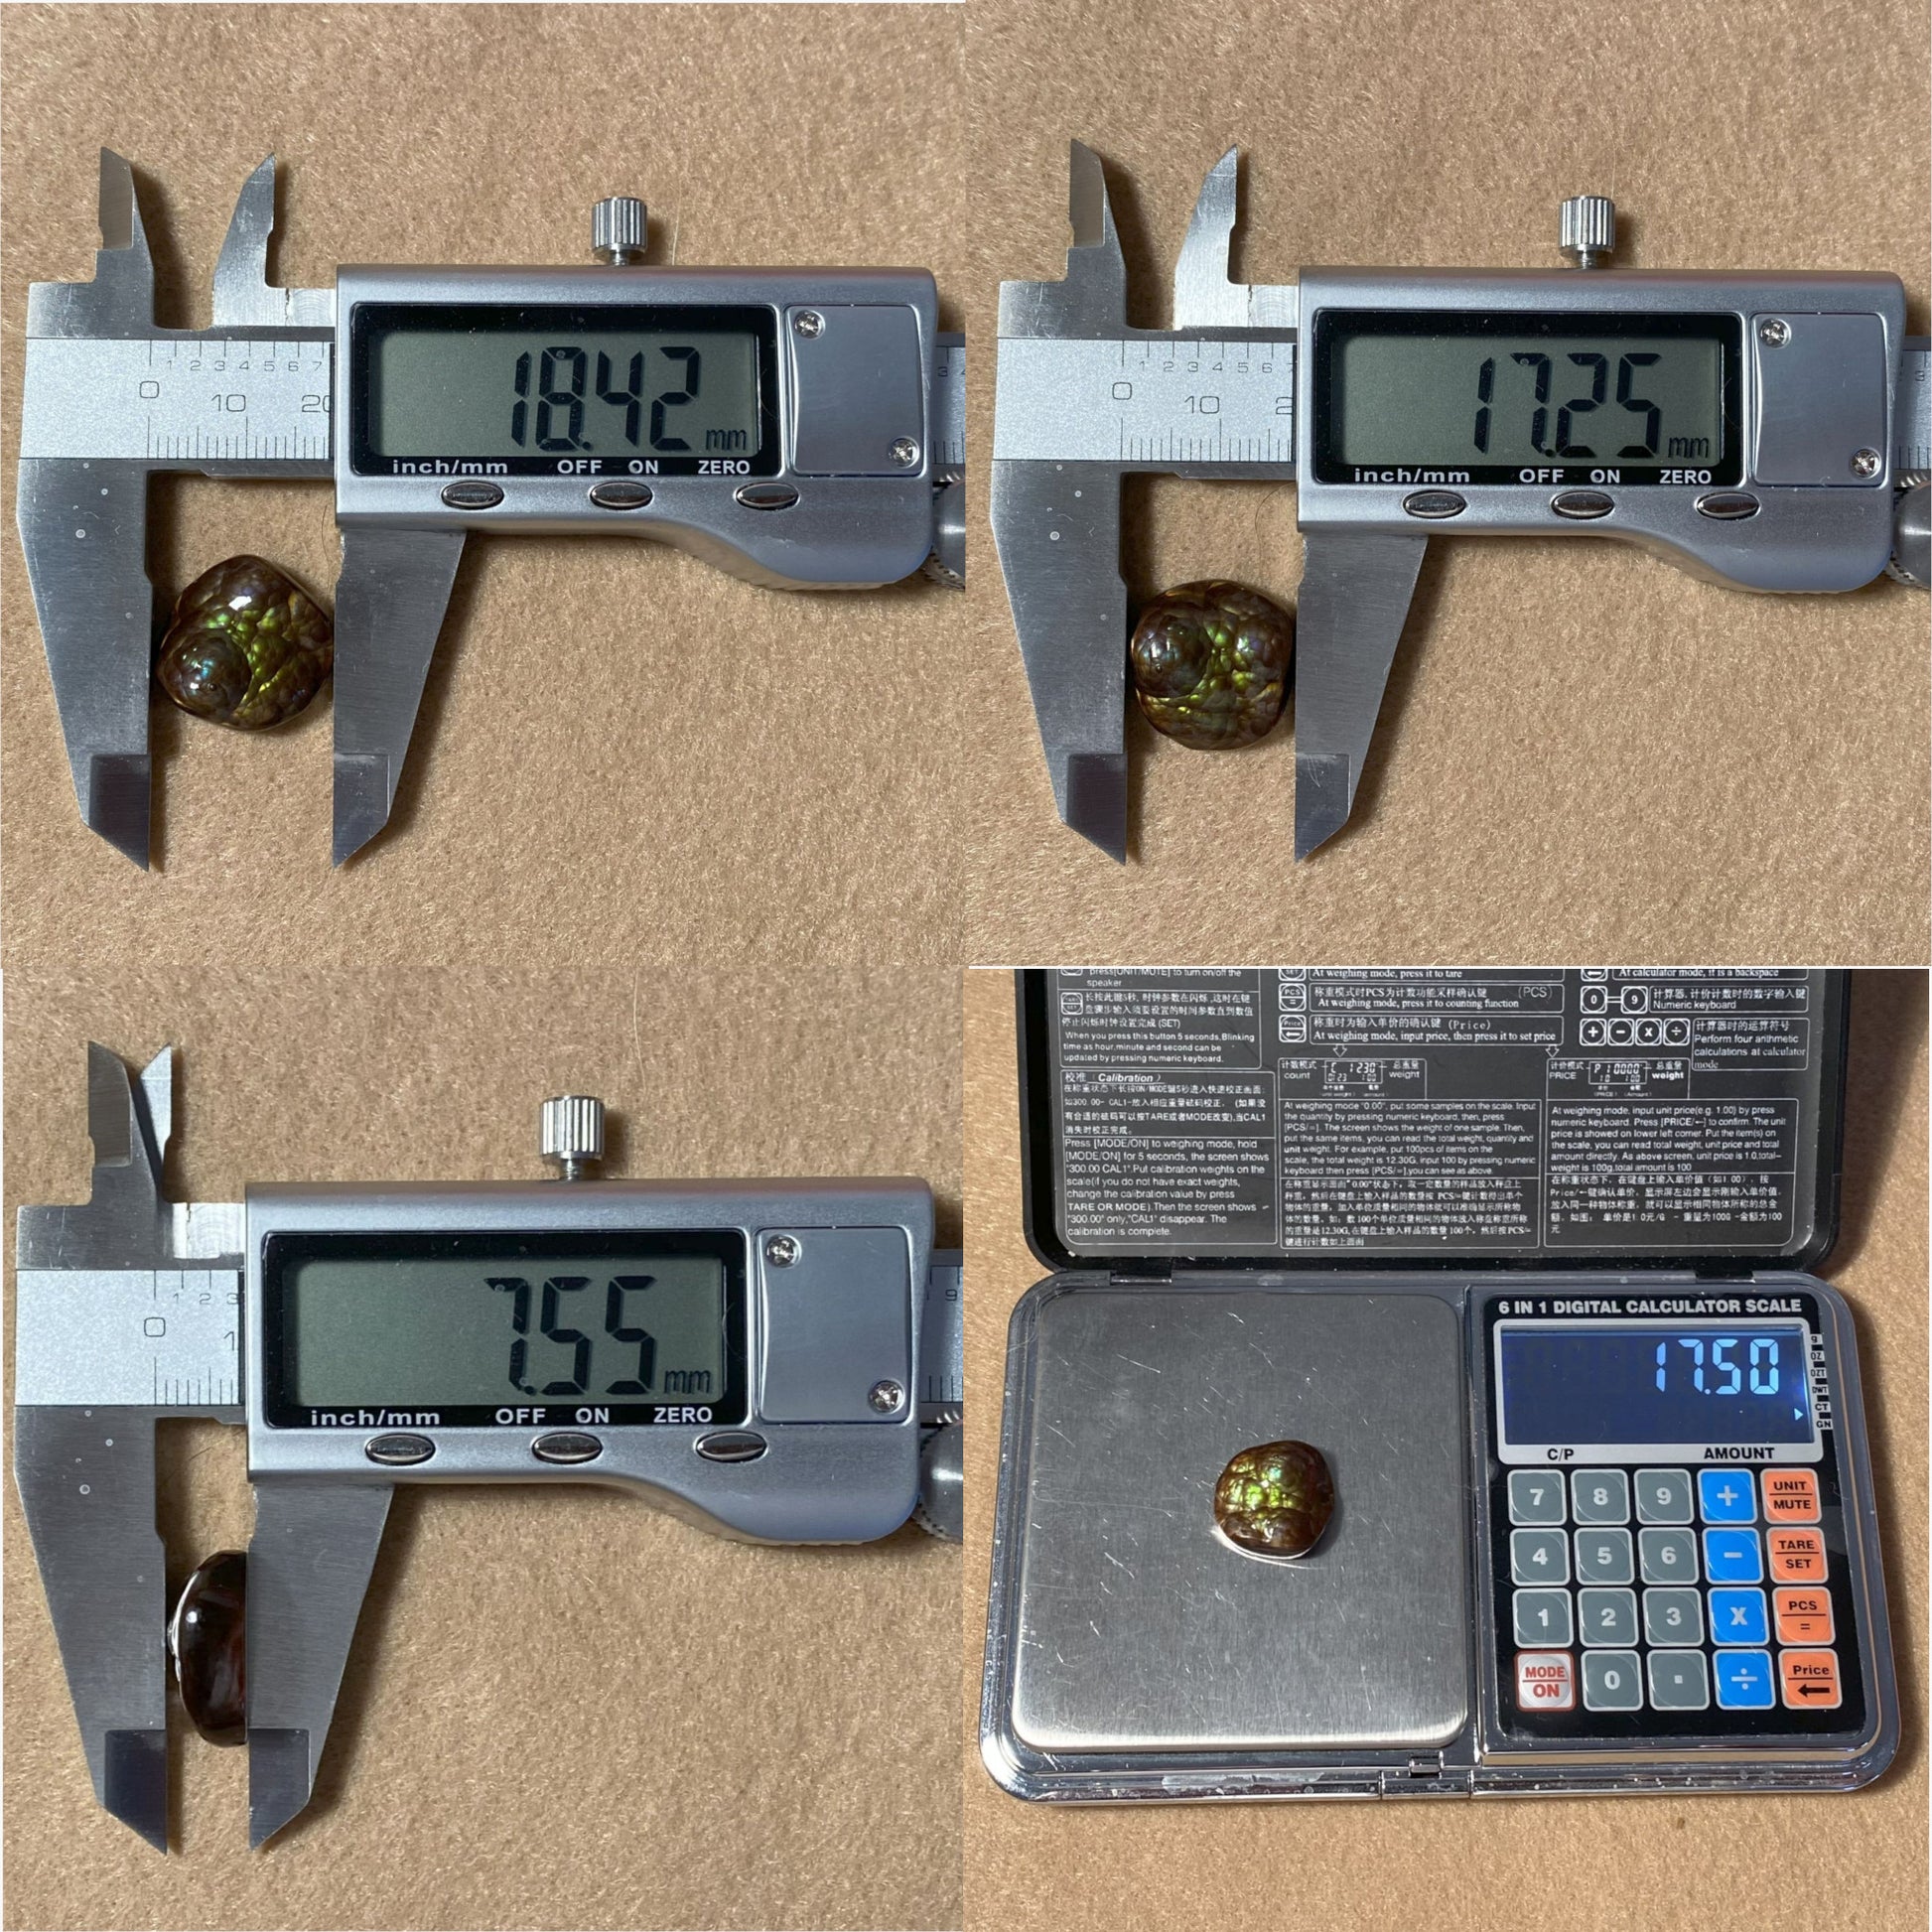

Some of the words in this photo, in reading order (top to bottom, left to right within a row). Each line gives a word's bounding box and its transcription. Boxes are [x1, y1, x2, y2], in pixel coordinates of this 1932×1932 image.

[167, 360, 173, 370] 1
[191, 360, 201, 371] 2
[214, 360, 225, 371] 3
[239, 360, 249, 370] 4
[264, 360, 275, 371] 5
[288, 361, 299, 371] 6
[313, 361, 323, 371] 7
[1140, 360, 1147, 370] 1
[1164, 361, 1173, 372] 2
[1187, 361, 1199, 372] 3
[1212, 361, 1223, 371] 4
[1237, 362, 1249, 373] 5
[1262, 362, 1273, 373] 6
[139, 380, 160, 398] 0
[210, 393, 246, 412] 10
[511, 346, 700, 452] 18.42
[1112, 381, 1133, 400] 0
[1184, 395, 1220, 414] 10
[1473, 352, 1662, 459] 17.25
[705, 428, 748, 451] mm
[1667, 436, 1711, 459] mm
[393, 459, 508, 476] inch/mm
[557, 459, 603, 476] OFF
[627, 459, 659, 476] ON
[698, 459, 751, 476] ZERO
[1354, 468, 1470, 484] inch/mm
[1519, 469, 1564, 484] OFF
[1589, 469, 1621, 484] ON
[1659, 469, 1713, 485] ZERO
[1087, 979, 1122, 988] speaker
[1331, 999, 1371, 1009] weighing
[1373, 999, 1400, 1008] mode,
[1402, 1001, 1424, 1010] press
[1446, 1000, 1482, 1010] counting
[1653, 1000, 1692, 1010] Numeric
[1694, 1000, 1736, 1012] keyboard
[1327, 1032, 1368, 1042] weighing
[1371, 1032, 1399, 1041] mode,
[1401, 1032, 1424, 1042] input
[1426, 1032, 1450, 1042] price,
[1453, 1032, 1472, 1040] then
[1474, 1034, 1497, 1042] press
[1500, 1032, 1507, 1040] it
[1534, 1033, 1556, 1042] price
[1389, 1070, 1420, 1080] weight
[1549, 1071, 1577, 1080] PRICE
[1652, 1071, 1685, 1081] weight
[173, 1293, 180, 1305] 1
[199, 1293, 211, 1305] 2
[226, 1293, 238, 1305] 3
[945, 1289, 957, 1302] 9
[1498, 1303, 1510, 1313] 6
[1514, 1302, 1533, 1313] IN
[1539, 1303, 1547, 1313] 1
[1554, 1301, 1622, 1313] DIGITAL
[1626, 1300, 1740, 1313] CALCULATOR
[1745, 1299, 1802, 1312] SCALE
[483, 1275, 659, 1396] 7.55
[1656, 1339, 1779, 1395] 17.50
[664, 1370, 712, 1395] mm
[311, 1410, 440, 1427] inch/mm
[495, 1408, 547, 1425] OFF
[575, 1408, 610, 1425] ON
[653, 1407, 713, 1424] ZERO
[1547, 1449, 1575, 1462] C/P
[1704, 1447, 1775, 1460] AMOUNT
[1773, 1480, 1807, 1491] UNIT
[1529, 1488, 1545, 1506] 7
[1593, 1488, 1608, 1505] 8
[1656, 1487, 1672, 1505] 9
[1773, 1499, 1812, 1510] MUTE
[1778, 1540, 1815, 1550] TARE
[1532, 1548, 1549, 1566] 4
[1597, 1547, 1612, 1565] 5
[1661, 1547, 1677, 1565] 6
[1785, 1559, 1812, 1570] SET
[1788, 1600, 1818, 1611] PCS
[1538, 1608, 1549, 1627] 1
[1601, 1608, 1617, 1627] 2
[1666, 1607, 1682, 1626] 3
[1525, 1666, 1566, 1679] MODE
[1793, 1665, 1830, 1676] Price
[1604, 1671, 1620, 1690] 0
[1532, 1685, 1561, 1699] ON
